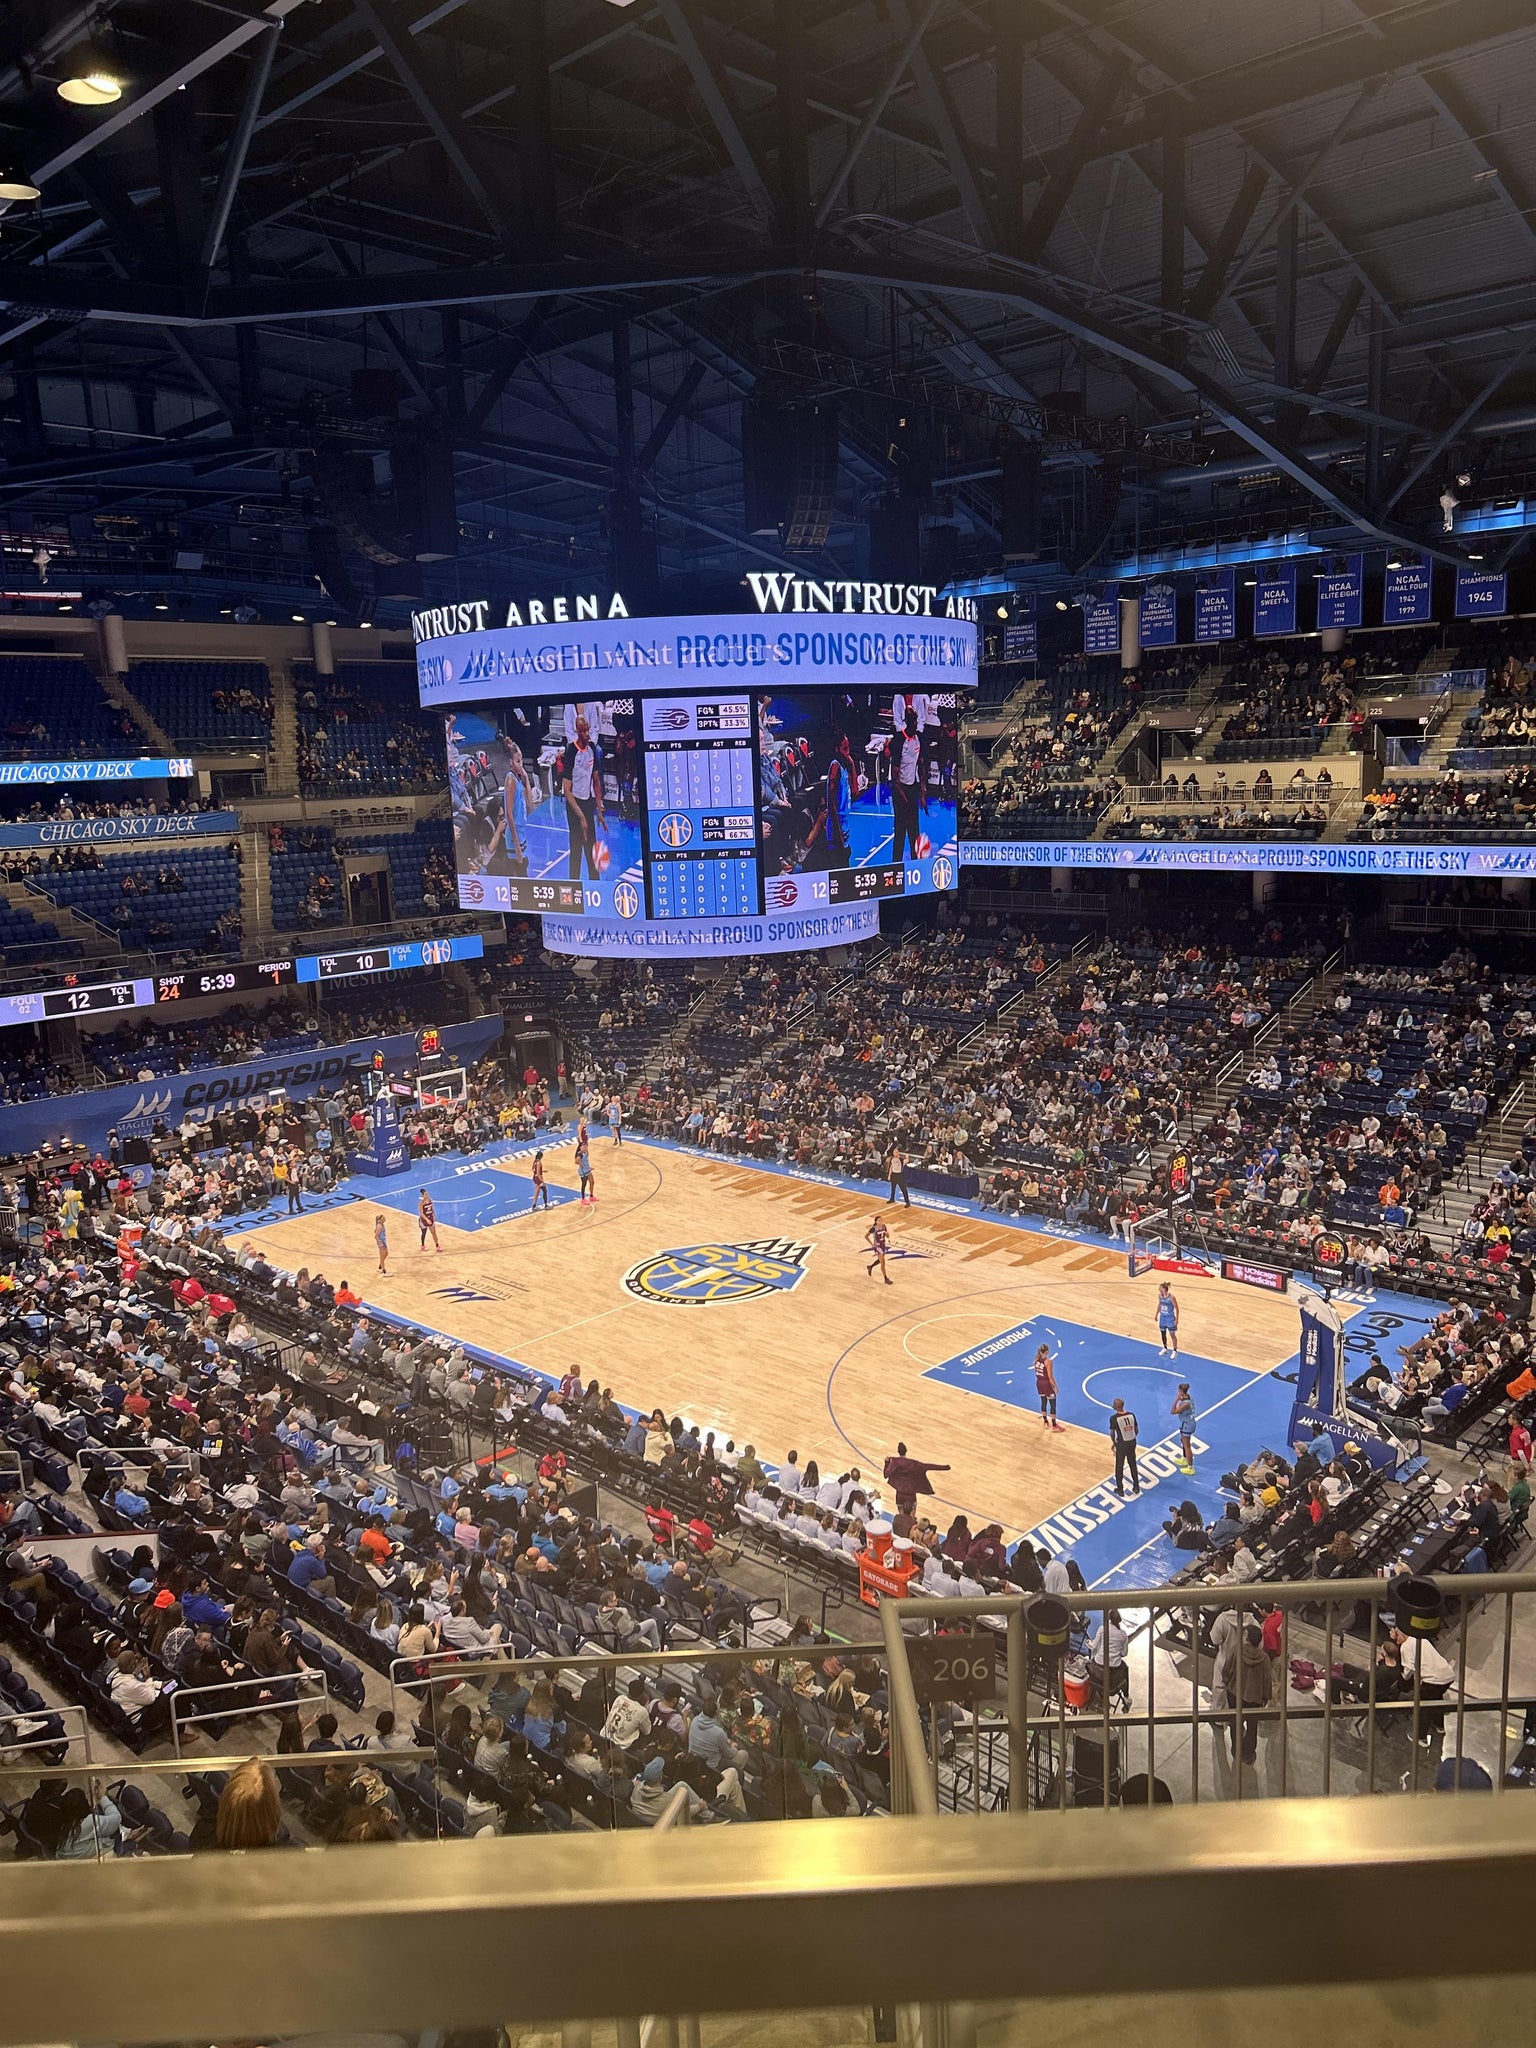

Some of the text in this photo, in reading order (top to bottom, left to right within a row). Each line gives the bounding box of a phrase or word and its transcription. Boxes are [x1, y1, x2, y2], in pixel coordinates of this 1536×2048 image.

[1328, 582, 1351, 591] NCAA
[1396, 575, 1420, 584] NCAA
[1460, 575, 1503, 584] CHAMPIONS
[746, 573, 936, 616] WINTRUST
[1205, 597, 1225, 605] NCAA
[1265, 590, 1285, 598] NCAA
[1340, 590, 1359, 598] EIGHT
[1468, 592, 1493, 602] 1945
[506, 592, 628, 627] ARENA
[497, 640, 657, 676] MAGELLAN
[677, 633, 766, 669] PROUD
[778, 632, 886, 666] SPONSOR
[894, 633, 915, 665] OF
[920, 635, 945, 666] THE
[949, 637, 967, 667] SKY
[698, 719, 746, 728] 3PT% 33.3%
[62, 764, 92, 779] SKY
[100, 762, 135, 777] DECK
[40, 816, 198, 842] CHICAGO SKY DECK
[963, 846, 995, 862] PROUD
[1000, 846, 1050, 862] SPONSOR
[1054, 846, 1068, 862] OF
[1309, 849, 1376, 868] SPONSOR
[1405, 850, 1434, 870] THE
[1439, 851, 1471, 870] SKY
[855, 873, 877, 888] 5:39
[885, 878, 893, 886] 24
[907, 870, 921, 886] 10
[495, 886, 508, 902] 12
[533, 886, 554, 899] 5:39
[812, 882, 827, 899] 12
[562, 894, 572, 903] 24
[585, 890, 601, 907] 10
[712, 925, 762, 944] PROUD
[768, 918, 828, 941] SPONSOR
[832, 915, 845, 934] OF
[392, 946, 412, 955] FOUL
[321, 958, 338, 967] TOL
[356, 955, 373, 970] 10
[398, 954, 407, 962] 01
[258, 961, 291, 973] PERIOD
[159, 976, 185, 986] SHOT
[200, 974, 235, 991] 5:39
[271, 971, 279, 985] 1
[110, 986, 130, 996] TOL
[159, 986, 180, 1001] 24
[10, 996, 38, 1007] FOUL
[68, 993, 90, 1009] 12
[118, 996, 124, 1004] 5
[19, 1005, 31, 1014] 02
[421, 1038, 437, 1052] 24
[117, 1115, 172, 1132] MAGELLAN
[455, 1137, 588, 1176] PROGRESSIV
[1171, 1168, 1185, 1190] 24
[682, 1246, 799, 1281] SKY
[628, 1281, 697, 1304] CHICAGO
[959, 1327, 1033, 1368] PROGRESSIVE
[1123, 1417, 1130, 1425] 11
[866, 1538, 874, 1550] G
[896, 1553, 902, 1561] G
[864, 1570, 898, 1592] GATORADE
[933, 1657, 989, 1682] 206
